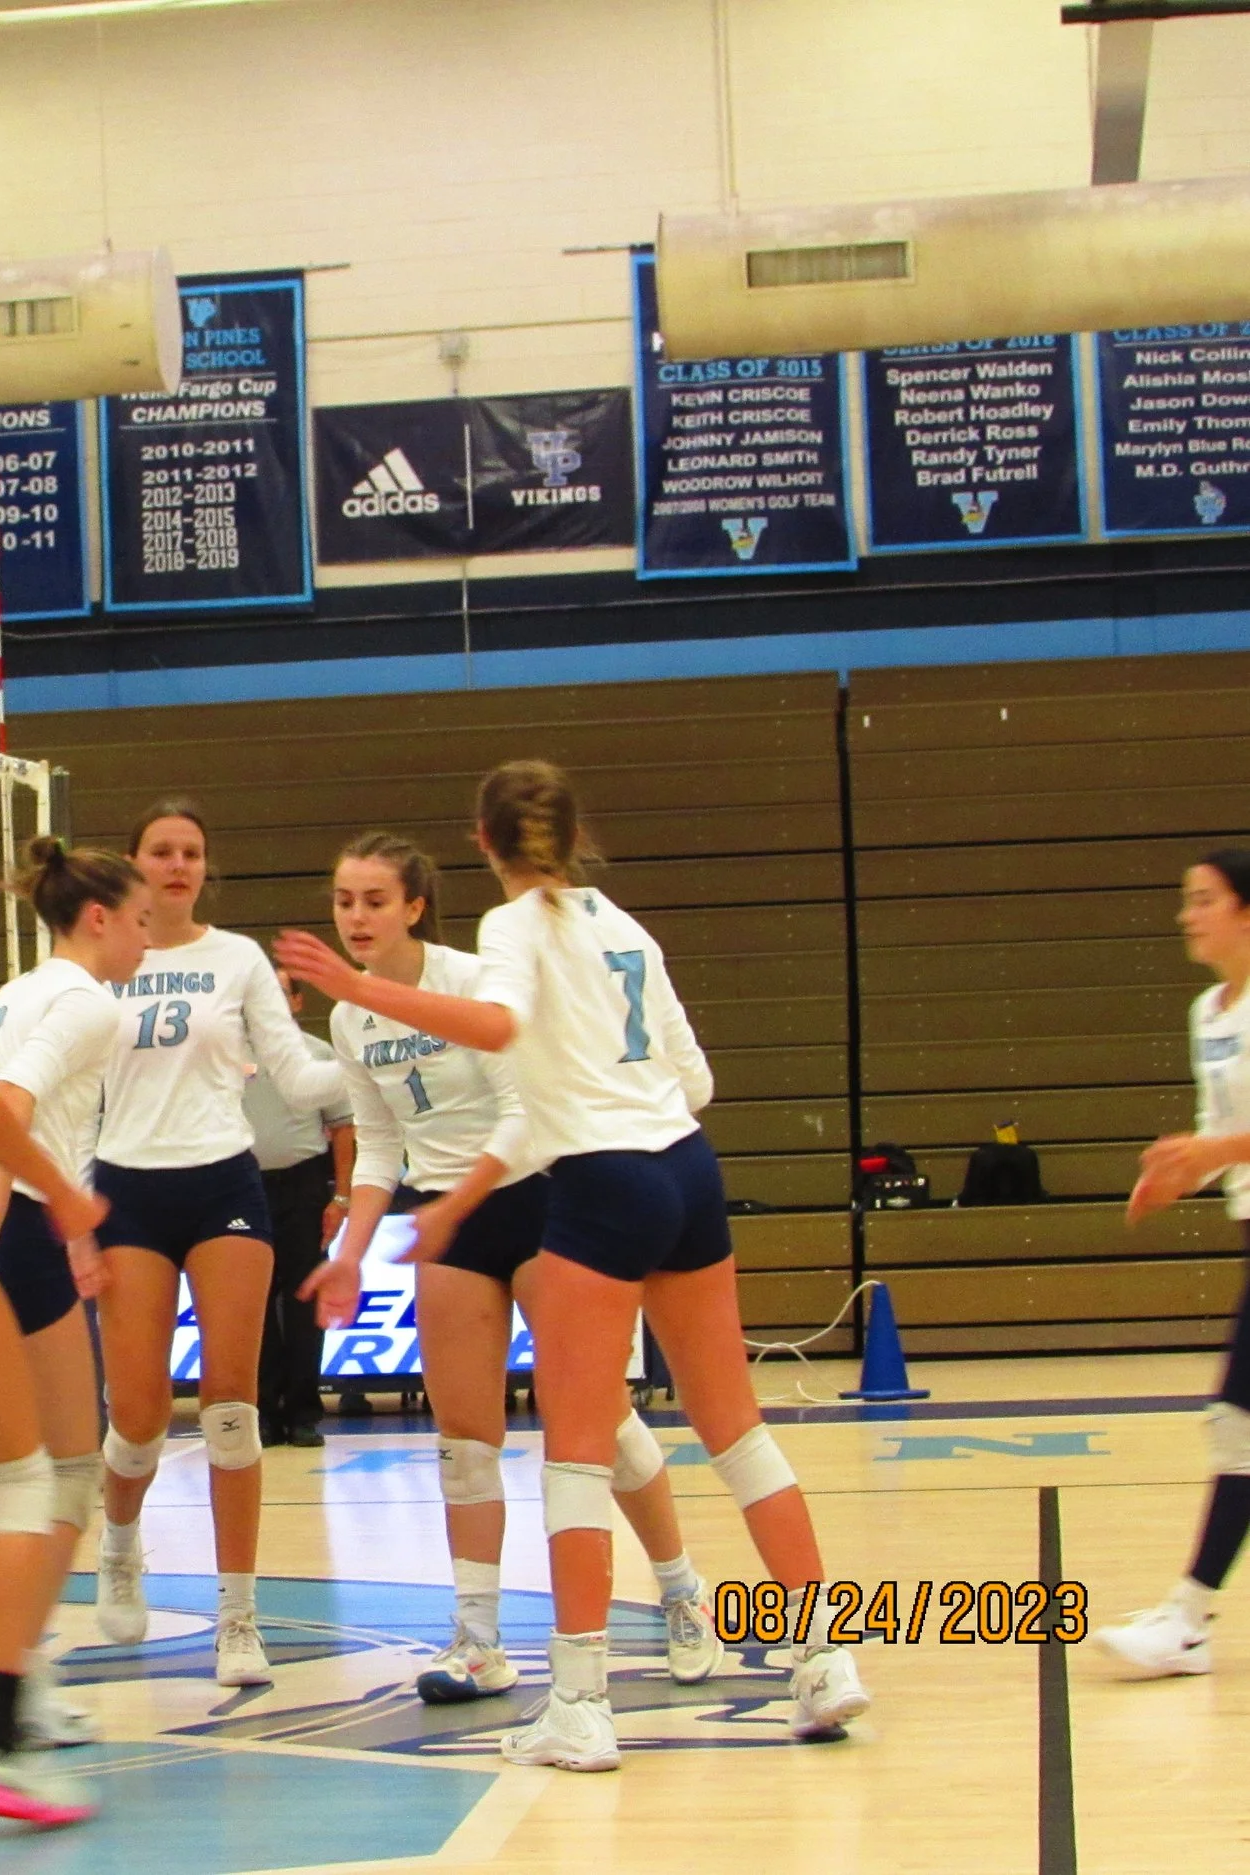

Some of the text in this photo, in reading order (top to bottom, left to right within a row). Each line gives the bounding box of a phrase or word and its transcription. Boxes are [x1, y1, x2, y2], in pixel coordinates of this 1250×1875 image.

[205, 327, 261, 346] PINES
[185, 349, 266, 369] SCHOOL
[1135, 350, 1184, 366] Nick
[658, 359, 822, 382] CLASS OF 2015
[886, 360, 1053, 387] Spencer Walden
[1123, 373, 1196, 389] Alishia
[178, 381, 233, 399] Fargo
[238, 378, 277, 396] Cup
[671, 386, 811, 407] KEVIN CRISCOE
[900, 381, 1041, 405] Neena Wanko
[132, 401, 266, 423] CHAMPIONS
[894, 402, 1055, 426] Robert Hoadley
[1130, 396, 1196, 411] Jason
[672, 408, 811, 429] KEITH CRISCOE
[1128, 418, 1187, 434] Emily
[662, 429, 823, 451] JOHNNY JAMISON
[905, 424, 1039, 447] Derrick Ross
[1188, 438, 1228, 454] Blue
[141, 438, 256, 461] 2010-2011
[911, 444, 1043, 466] Randy Tyner
[667, 450, 819, 472] LEONARD SMITH
[1135, 463, 1184, 478] M.D.
[142, 462, 258, 485] 2011-2012
[662, 475, 754, 494] WOODROW
[916, 464, 1038, 487] Brad Futrell
[142, 481, 236, 508] 2012-2013
[342, 490, 441, 518] adidas
[511, 485, 601, 507] VIKINGS
[803, 493, 836, 507] TEAM
[142, 506, 235, 531] 2014-2015
[142, 528, 238, 551] 2017-2018
[144, 548, 240, 573] 2018-2019
[111, 972, 215, 999] VIKINGS
[602, 950, 652, 1063] 7
[133, 1000, 191, 1050] 13
[404, 1066, 433, 1114] 1
